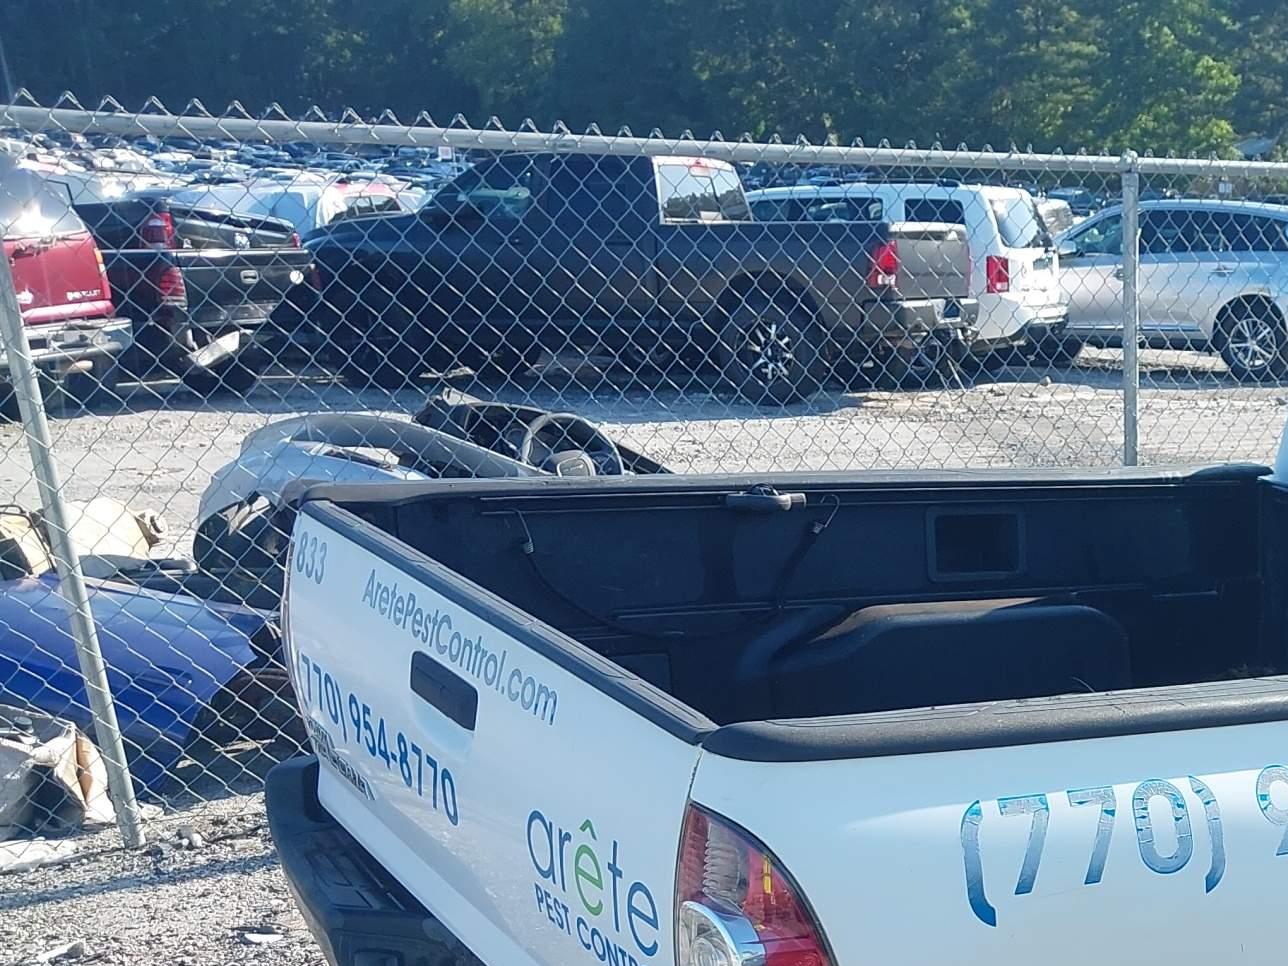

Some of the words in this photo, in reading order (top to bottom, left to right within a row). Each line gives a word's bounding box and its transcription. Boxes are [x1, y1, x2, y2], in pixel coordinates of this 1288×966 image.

[296, 531, 328, 585] 833
[362, 568, 558, 726] AretePestControl.com
[349, 692, 459, 827] 954-8770
[534, 882, 572, 936] PEST
[961, 774, 1226, 928] (770)
